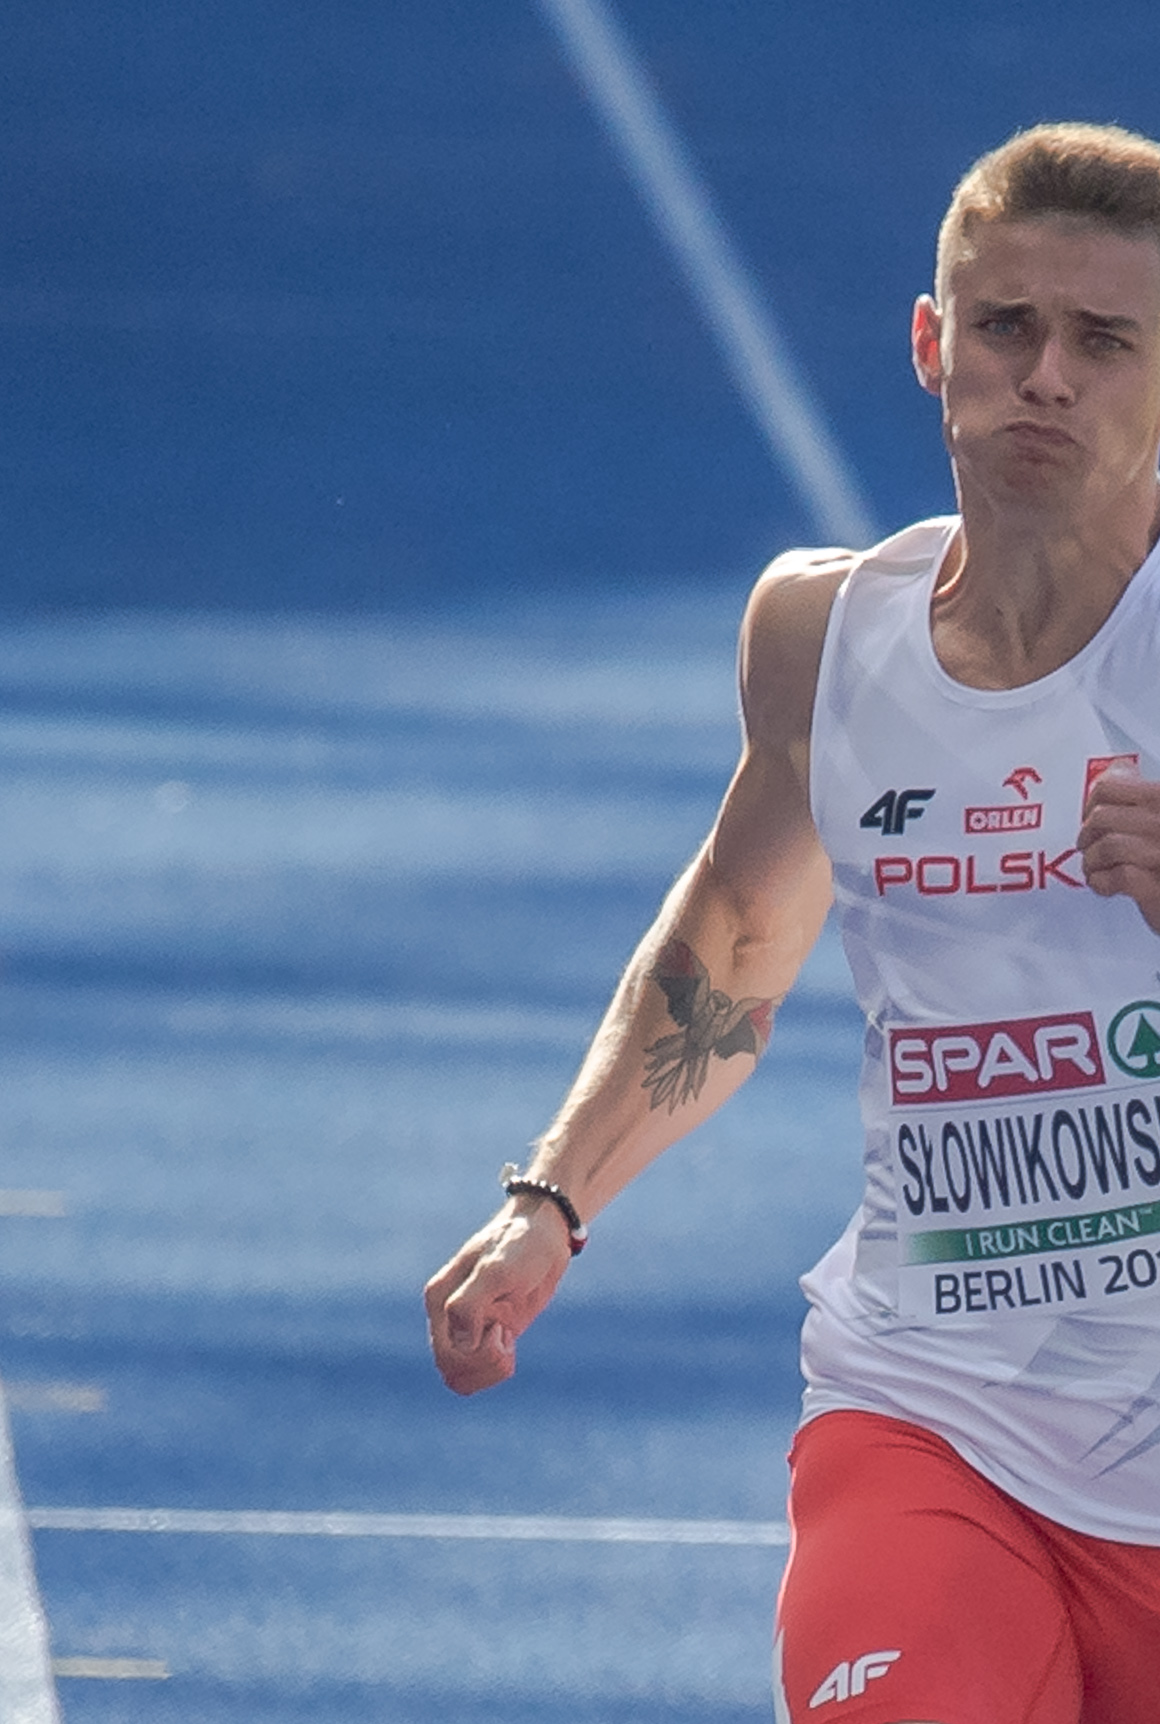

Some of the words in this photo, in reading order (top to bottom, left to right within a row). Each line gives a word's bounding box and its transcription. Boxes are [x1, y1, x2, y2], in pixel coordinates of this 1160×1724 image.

[859, 788, 936, 835] 4F
[969, 808, 1040, 829] ORLEN
[875, 849, 1086, 896] POLSK
[893, 1023, 1097, 1093] SPAR
[979, 1226, 1039, 1254] RUN
[934, 1259, 1087, 1315] BERLIN
[809, 1649, 901, 1709] 4F
